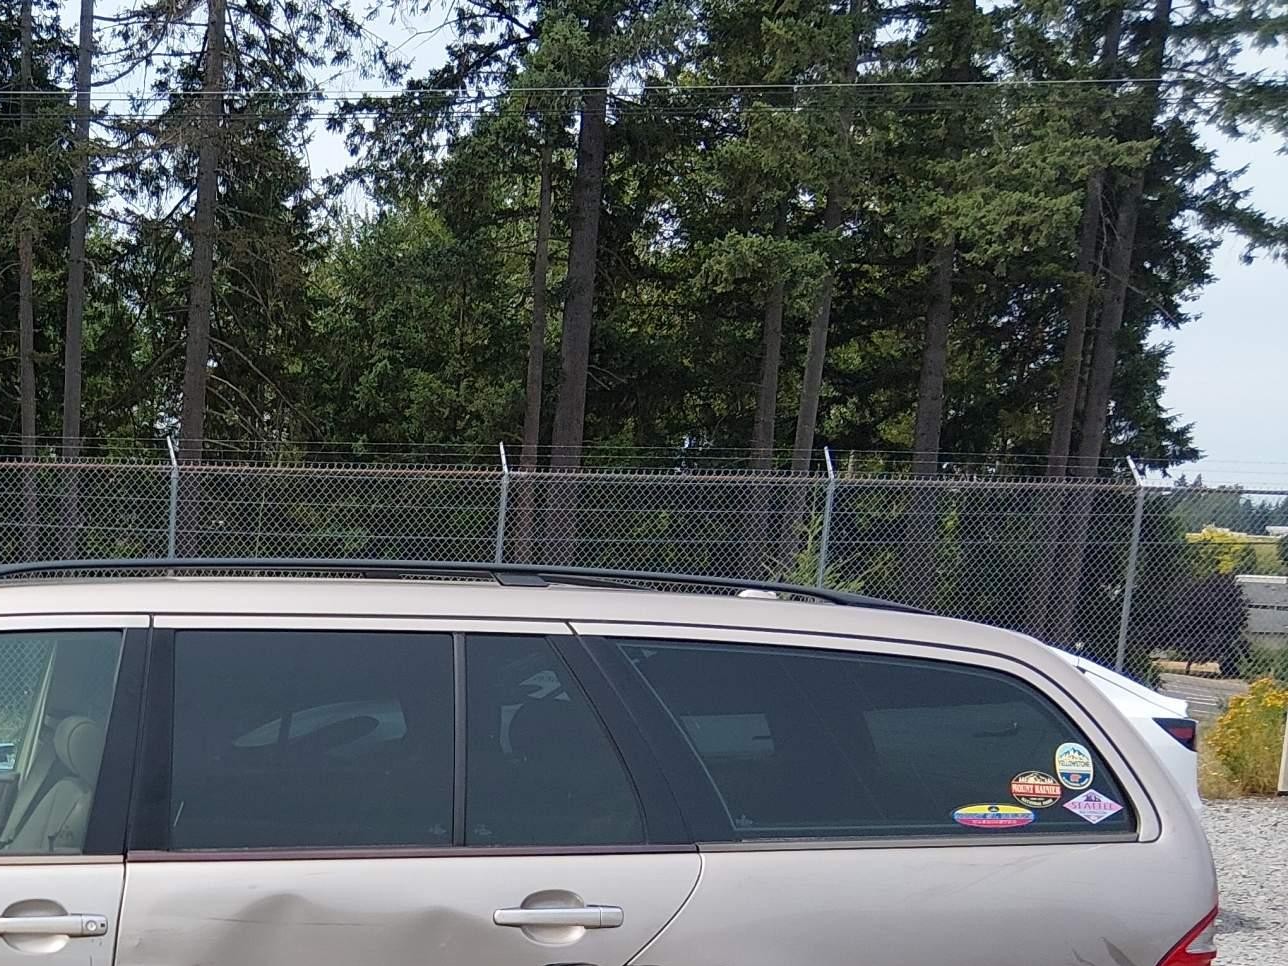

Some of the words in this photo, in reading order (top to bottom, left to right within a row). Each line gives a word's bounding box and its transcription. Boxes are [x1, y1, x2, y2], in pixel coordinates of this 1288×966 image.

[1058, 760, 1091, 768] YELLOWSTONE
[1012, 784, 1034, 794] MOUNT
[1035, 784, 1061, 795] RAINIER
[1070, 800, 1114, 812] SEATTLE
